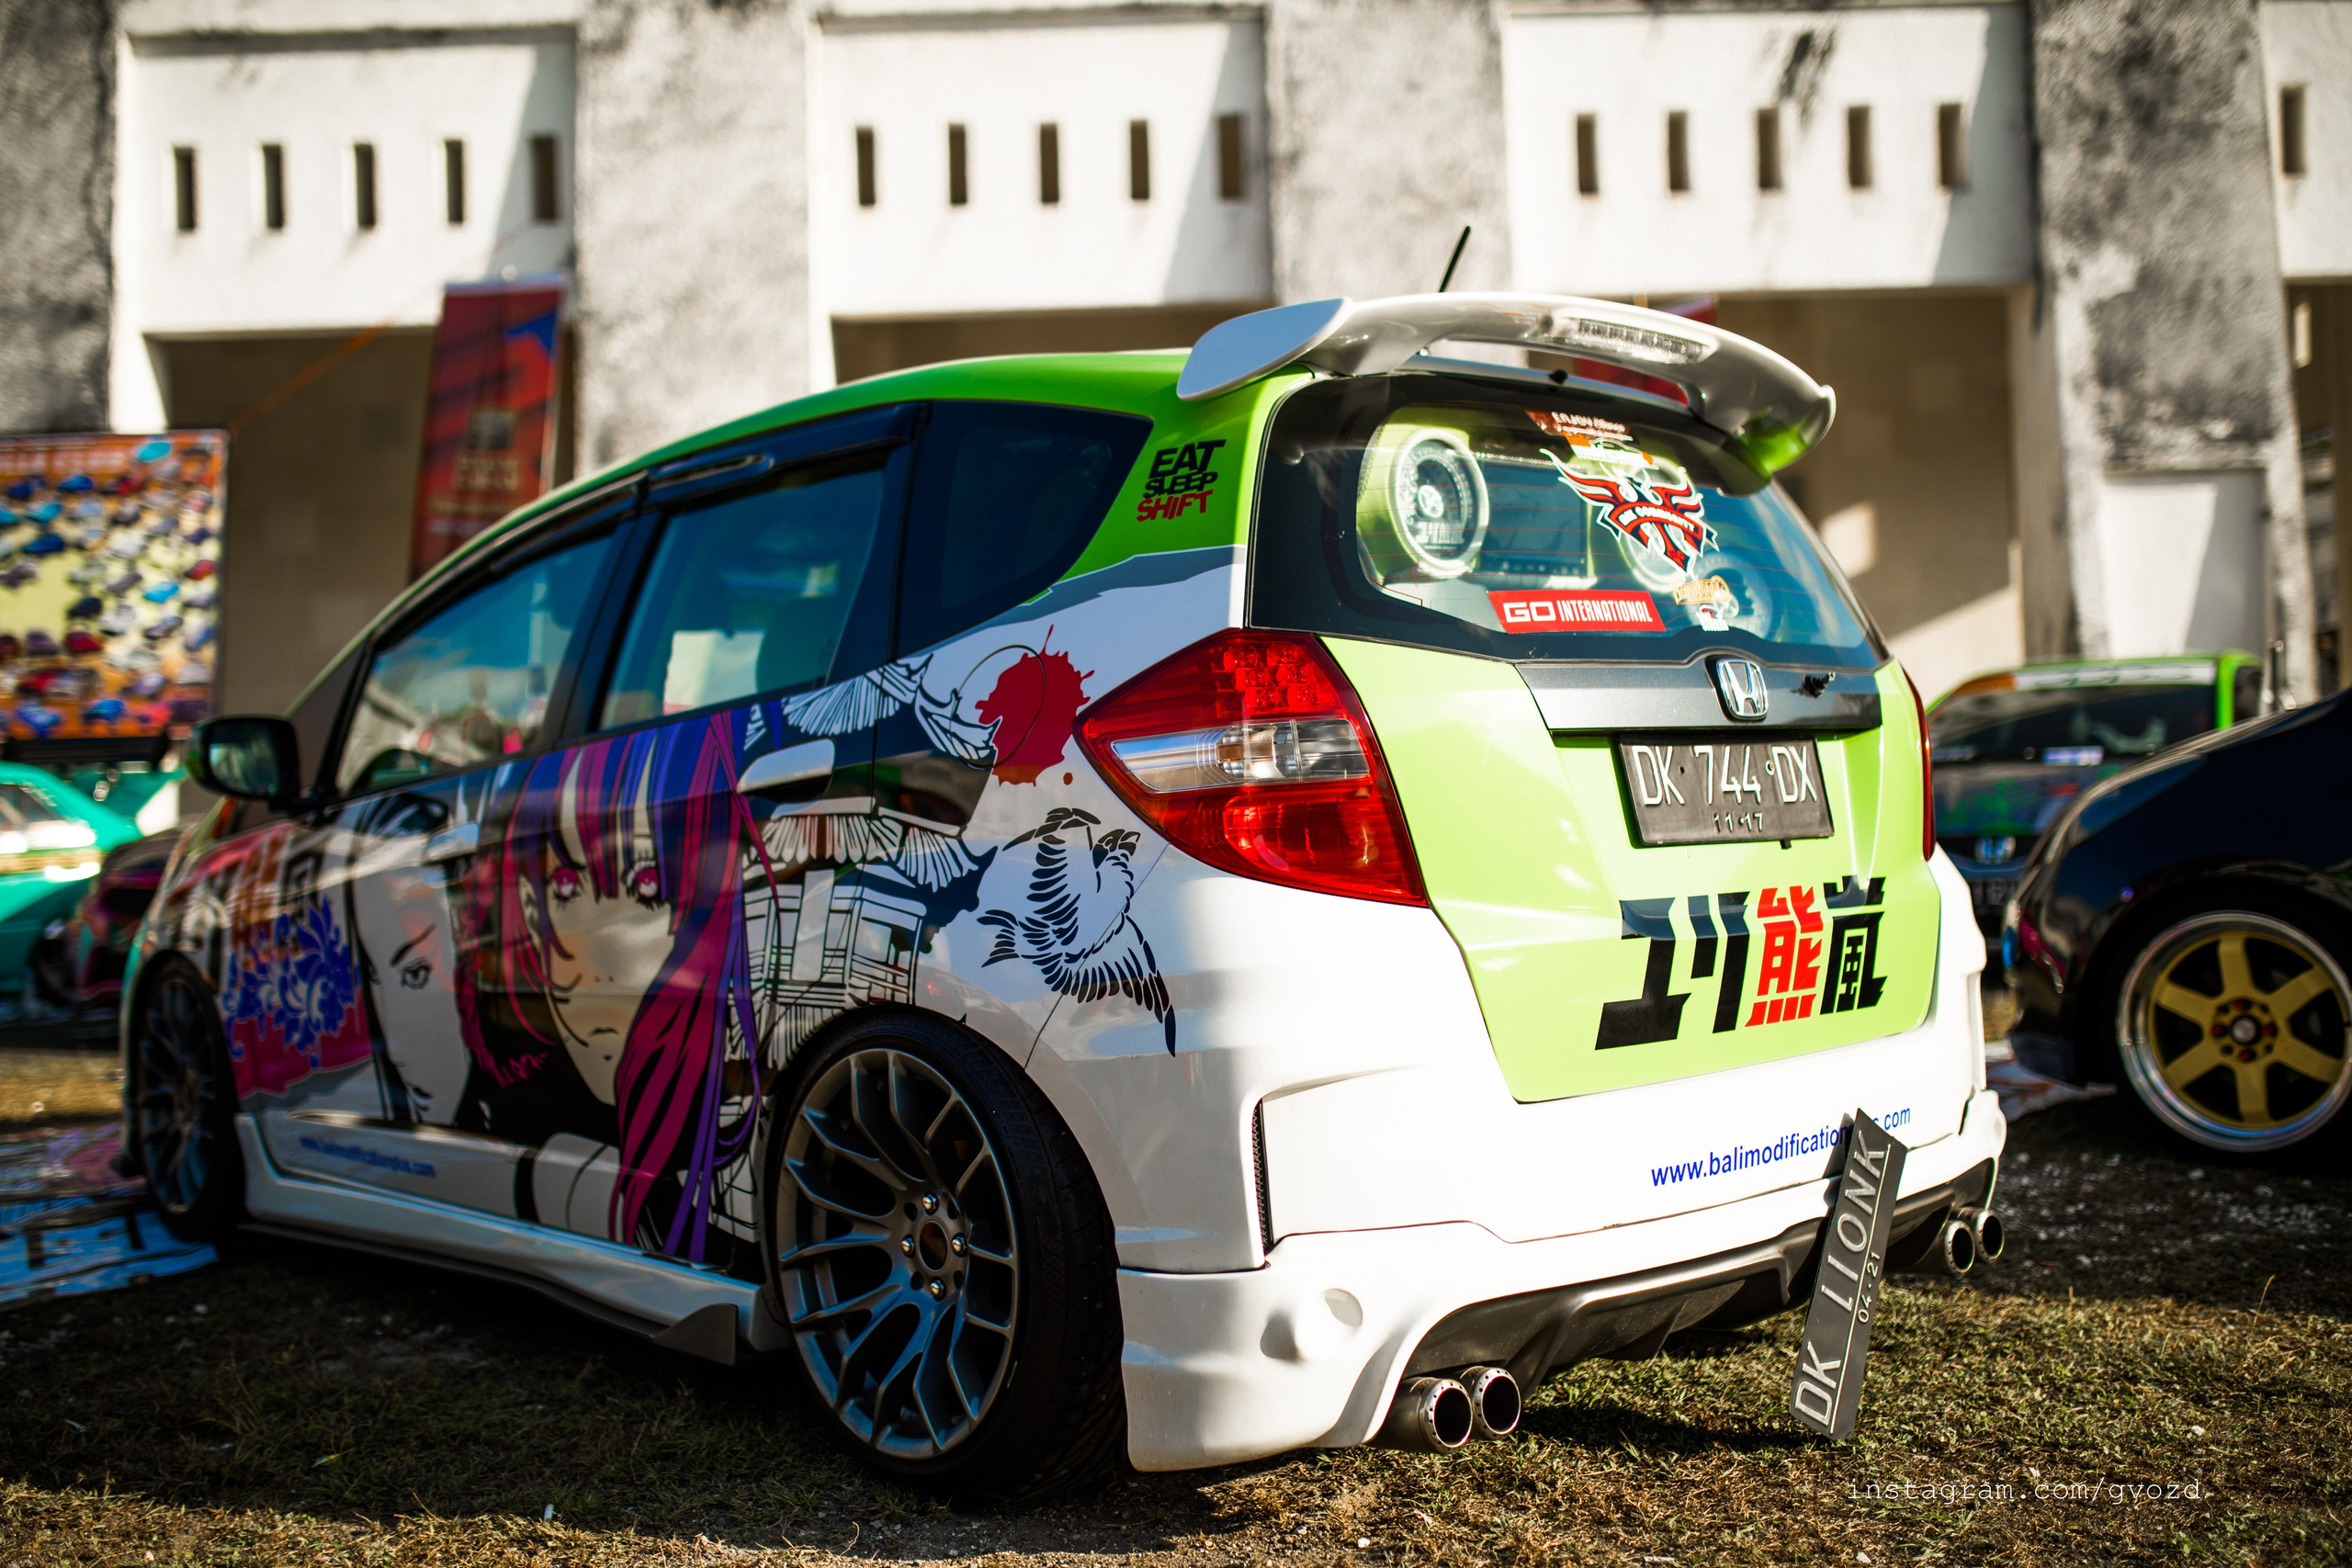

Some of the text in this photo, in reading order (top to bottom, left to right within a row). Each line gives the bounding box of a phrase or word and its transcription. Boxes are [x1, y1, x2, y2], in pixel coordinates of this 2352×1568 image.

[1148, 439, 1227, 479] EAT
[1142, 471, 1219, 499] SLEEP
[1136, 489, 1214, 523] SHIFT
[1502, 600, 1653, 623] GO INTERNATIONAL
[1631, 745, 1818, 806] DK 744 DX
[1794, 1341, 1842, 1426] DK
